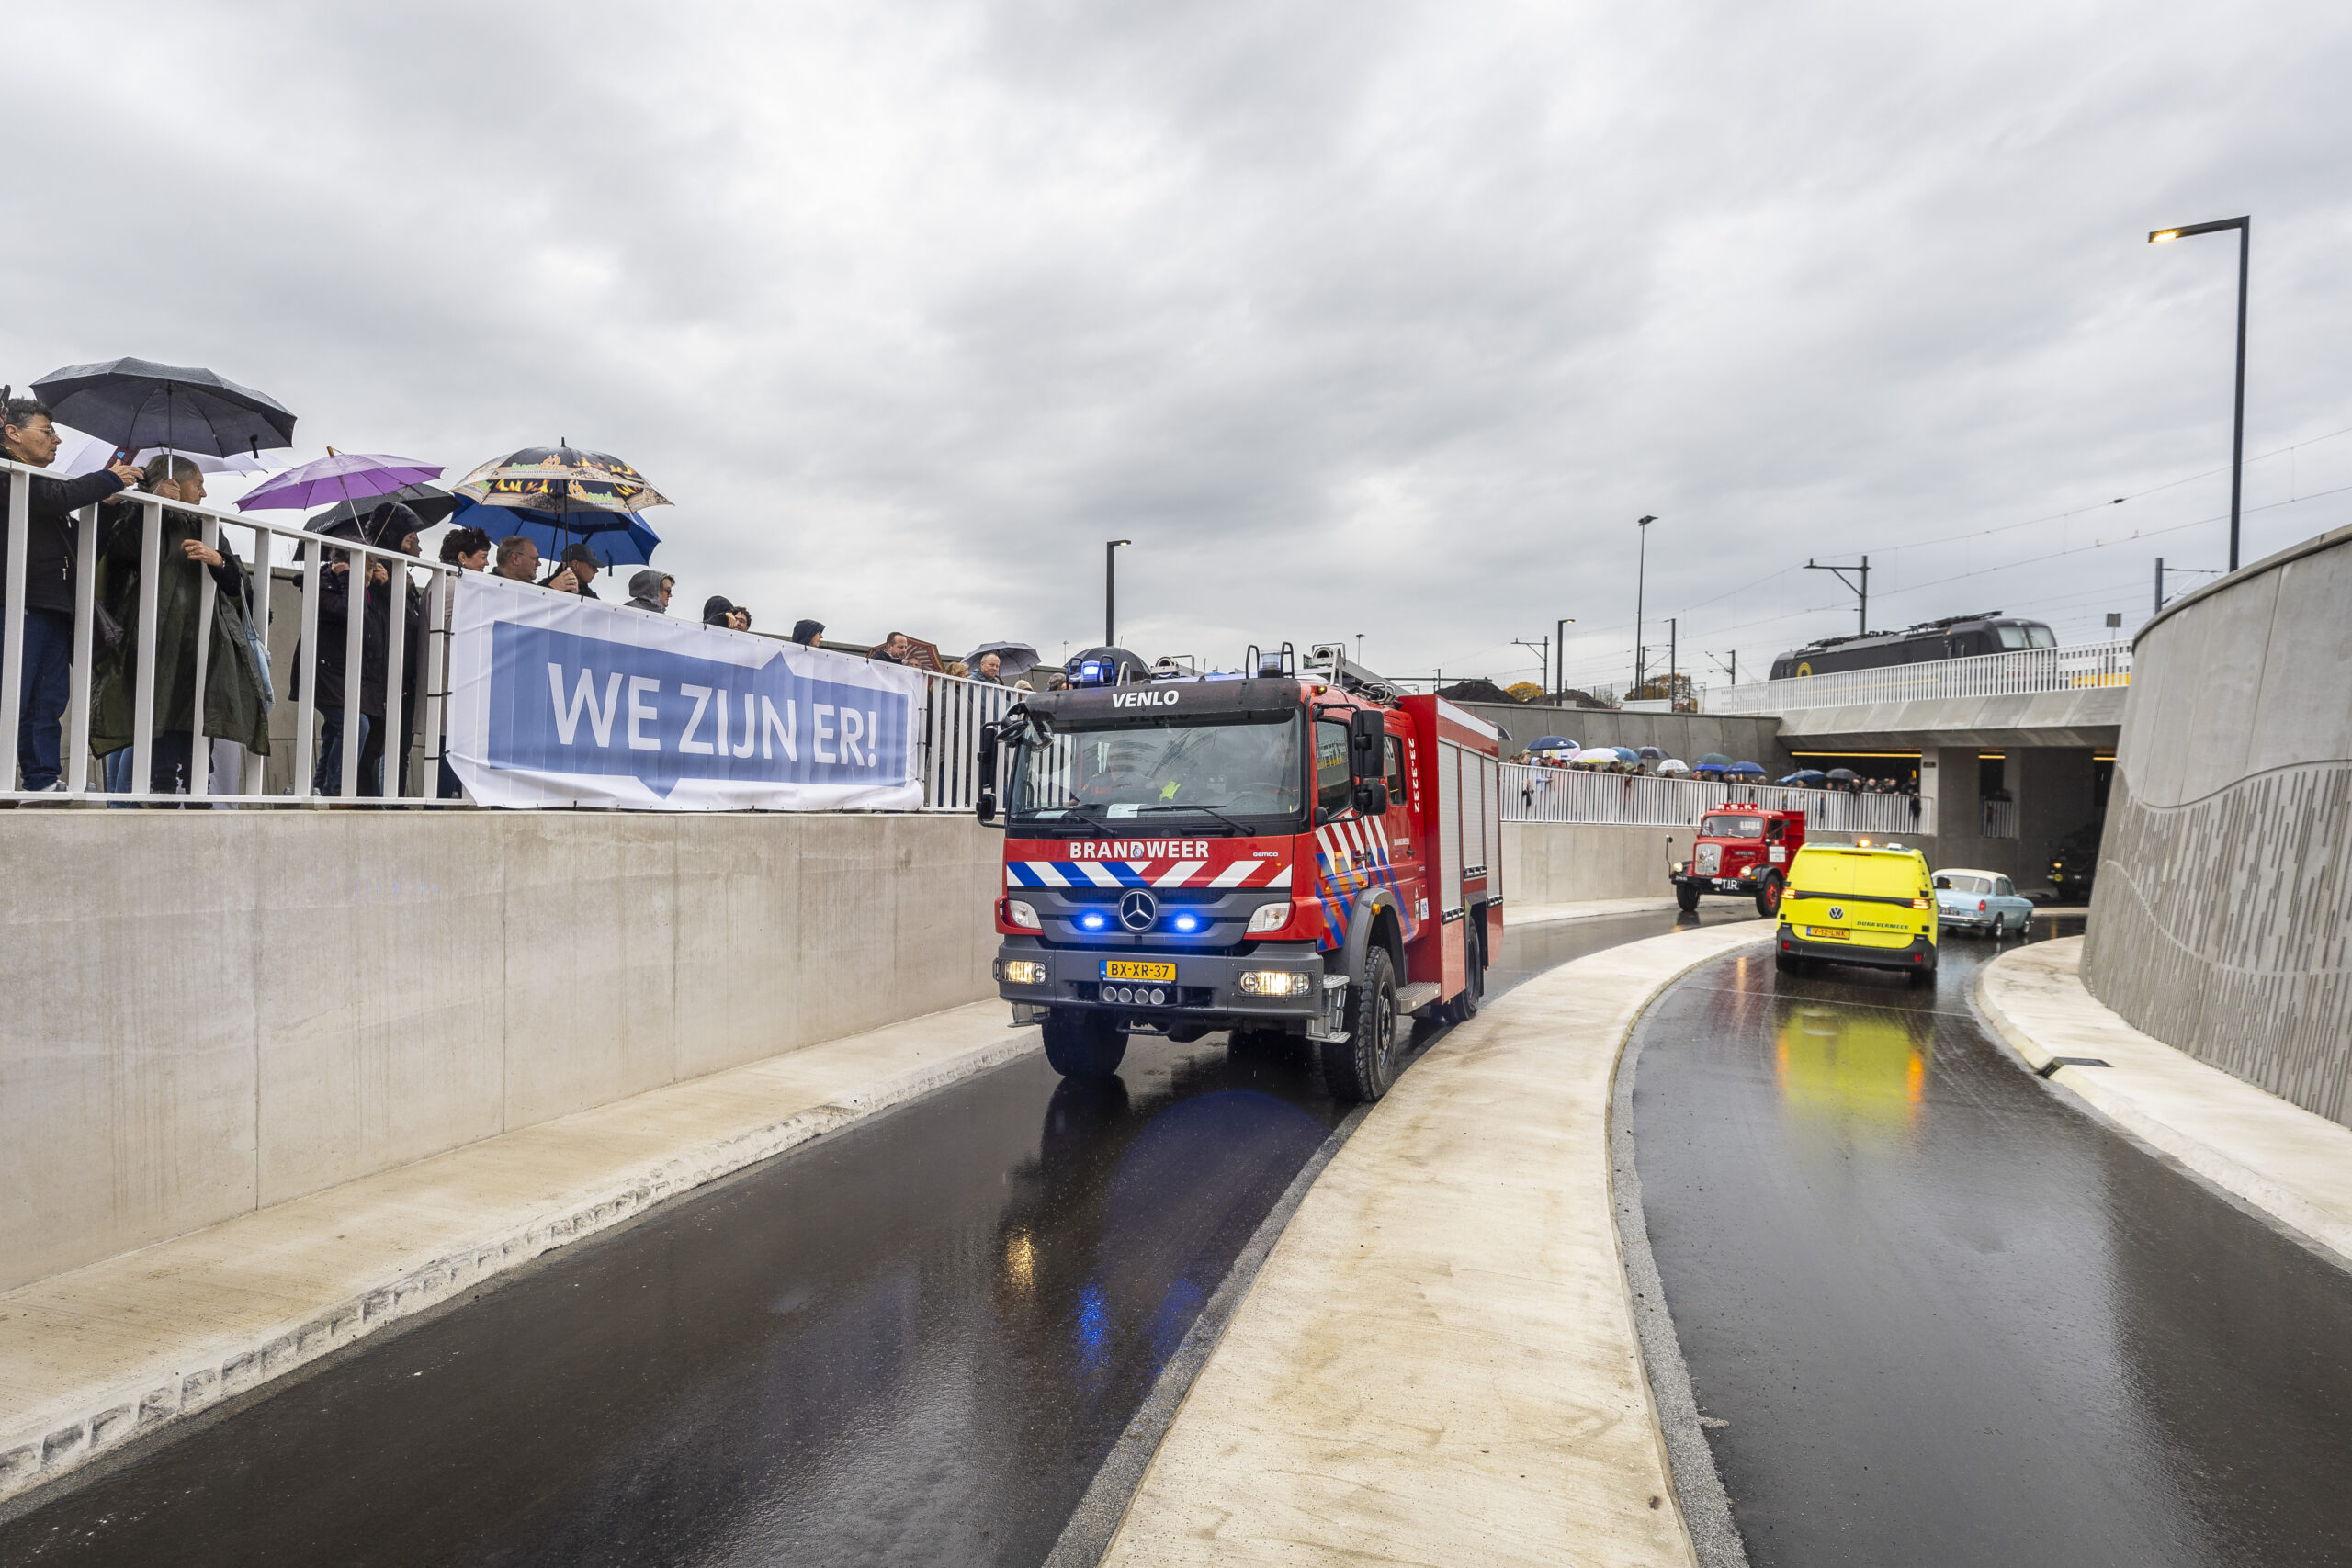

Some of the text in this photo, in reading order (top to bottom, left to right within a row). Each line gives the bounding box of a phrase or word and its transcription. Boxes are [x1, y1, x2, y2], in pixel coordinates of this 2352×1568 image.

[1112, 690, 1180, 708] VENLO
[548, 662, 877, 769] WE ZIJN ER!
[1408, 737, 1420, 813] 23-3232
[1069, 840, 1209, 859] BRANDWEER
[1722, 879, 1740, 890] TIR
[1814, 928, 1846, 937] V-12-LNK
[1111, 963, 1170, 978] BX-XR-37
